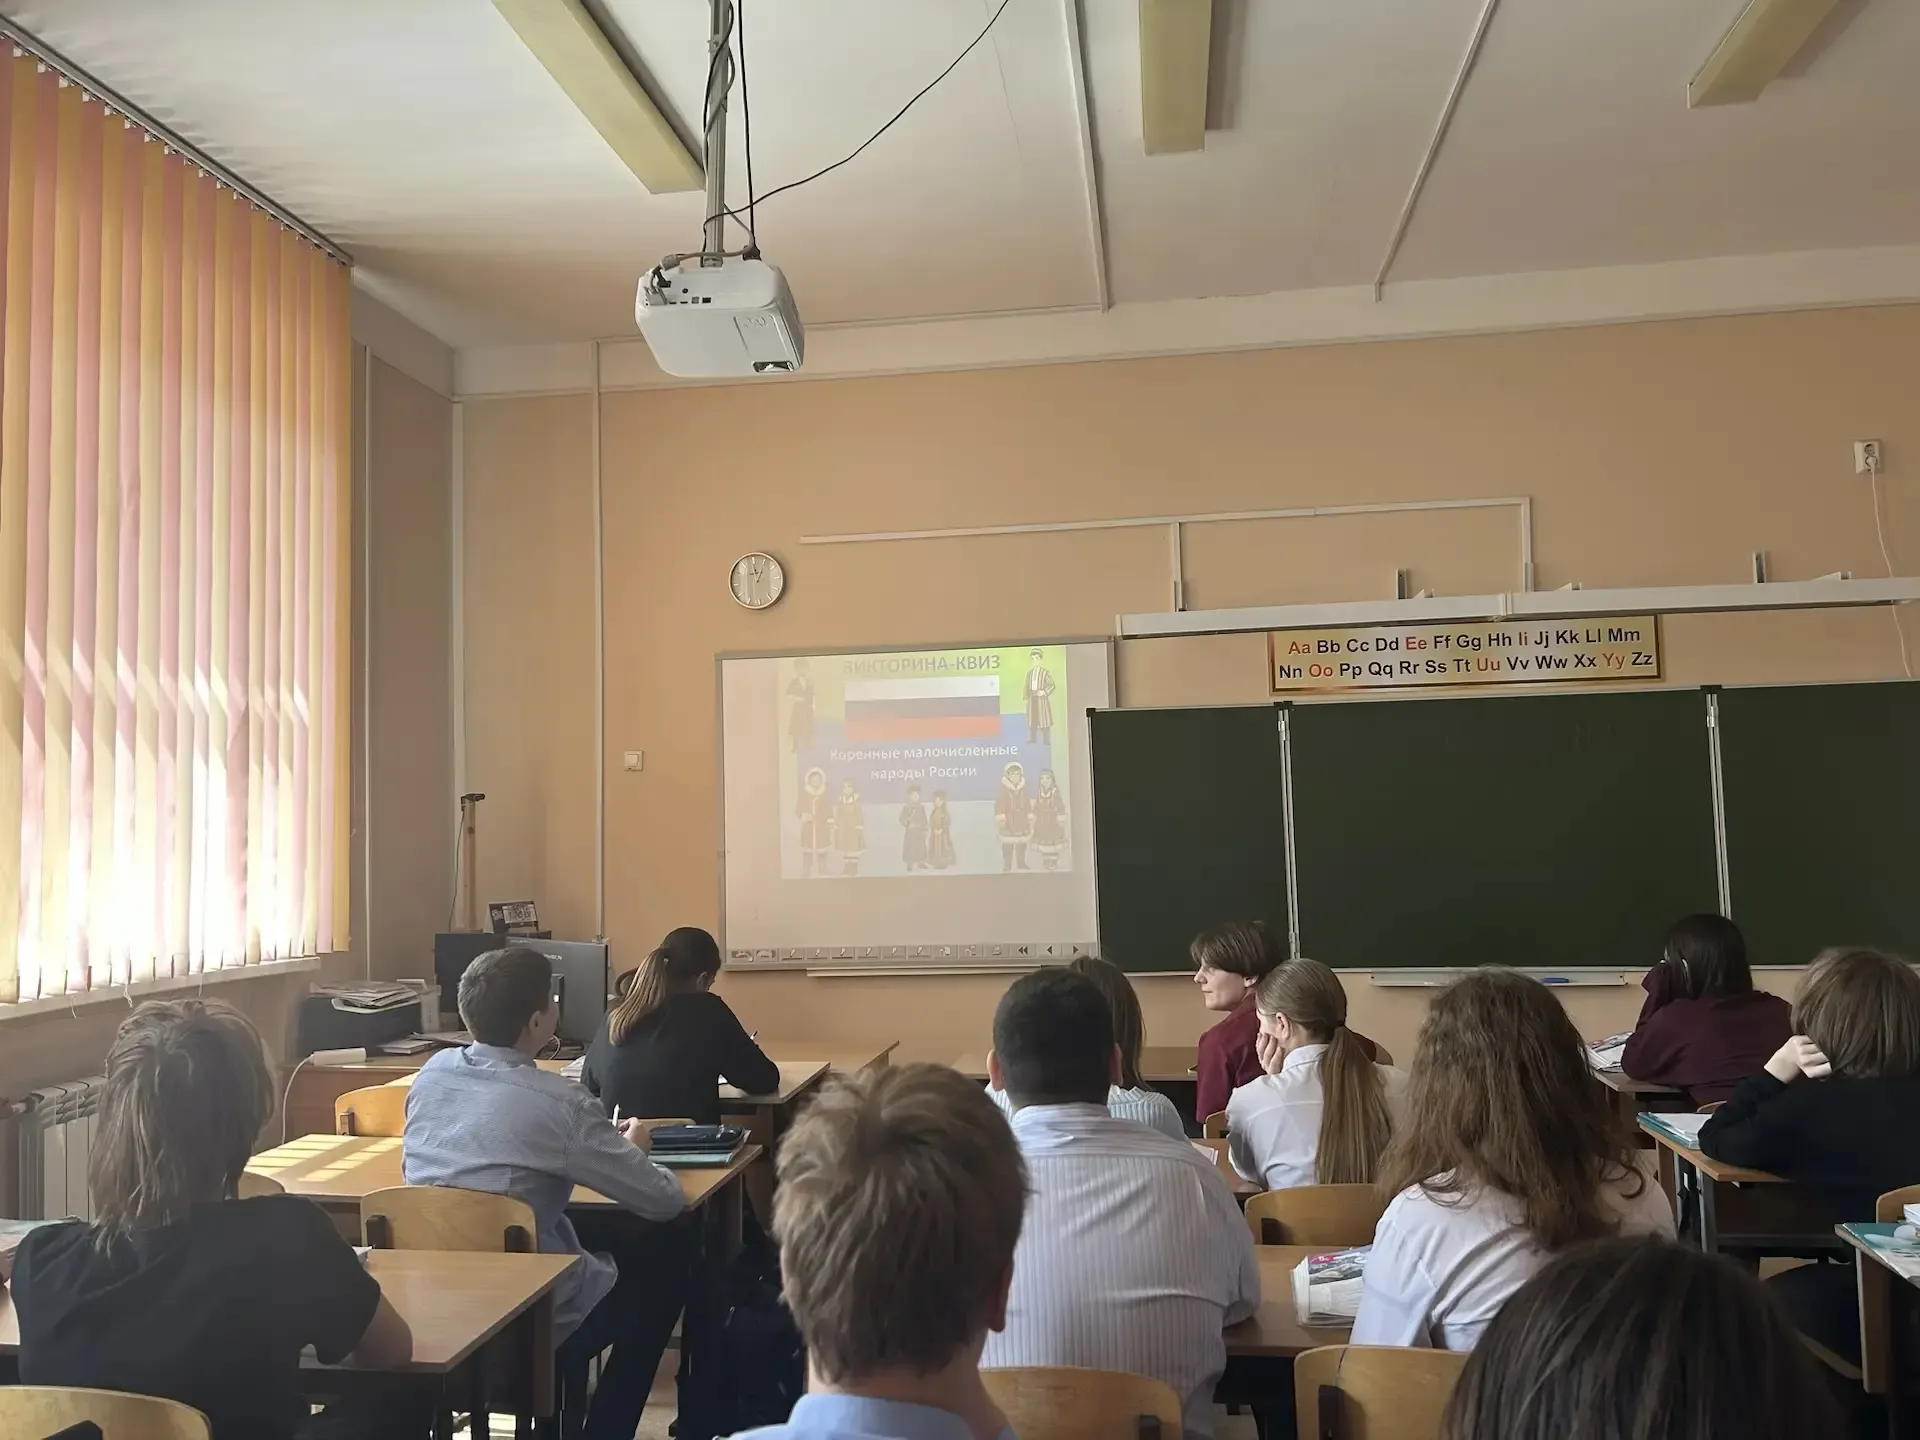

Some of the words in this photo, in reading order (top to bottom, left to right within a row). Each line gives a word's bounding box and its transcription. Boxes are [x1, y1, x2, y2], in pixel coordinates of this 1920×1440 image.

[1288, 641, 1311, 655] Aa
[1317, 639, 1341, 653] Bb
[1346, 638, 1370, 653] Cc
[1375, 637, 1399, 652] Dd
[1405, 636, 1428, 650] Ee
[1433, 634, 1451, 649] Ff
[1456, 634, 1482, 651] Gg
[1487, 632, 1512, 647] Hh
[1518, 631, 1528, 646] Ii
[1534, 630, 1549, 648] Jj
[1555, 629, 1580, 644] Kk
[1585, 628, 1601, 643] Ll
[1608, 627, 1640, 642] Mm
[844, 655, 1000, 674] ВИКТОРИНА-КВИЗ
[1279, 664, 1302, 679] Nn
[1308, 663, 1333, 678] Oo
[1339, 662, 1362, 679] Pp
[1368, 661, 1393, 678] Qq
[1399, 660, 1420, 675] Rr
[1425, 659, 1447, 674] Ss
[1452, 658, 1471, 673] Tt
[1476, 657, 1500, 672] Uu
[1506, 656, 1530, 671] Vv
[1535, 655, 1568, 670] Ww
[1574, 653, 1597, 668] Xx
[1602, 652, 1626, 670] Yy
[1631, 651, 1653, 666] Zz
[830, 748, 900, 762] Коренные
[904, 745, 1018, 759] малочисленные
[871, 768, 925, 782] народы
[929, 765, 977, 778] России
